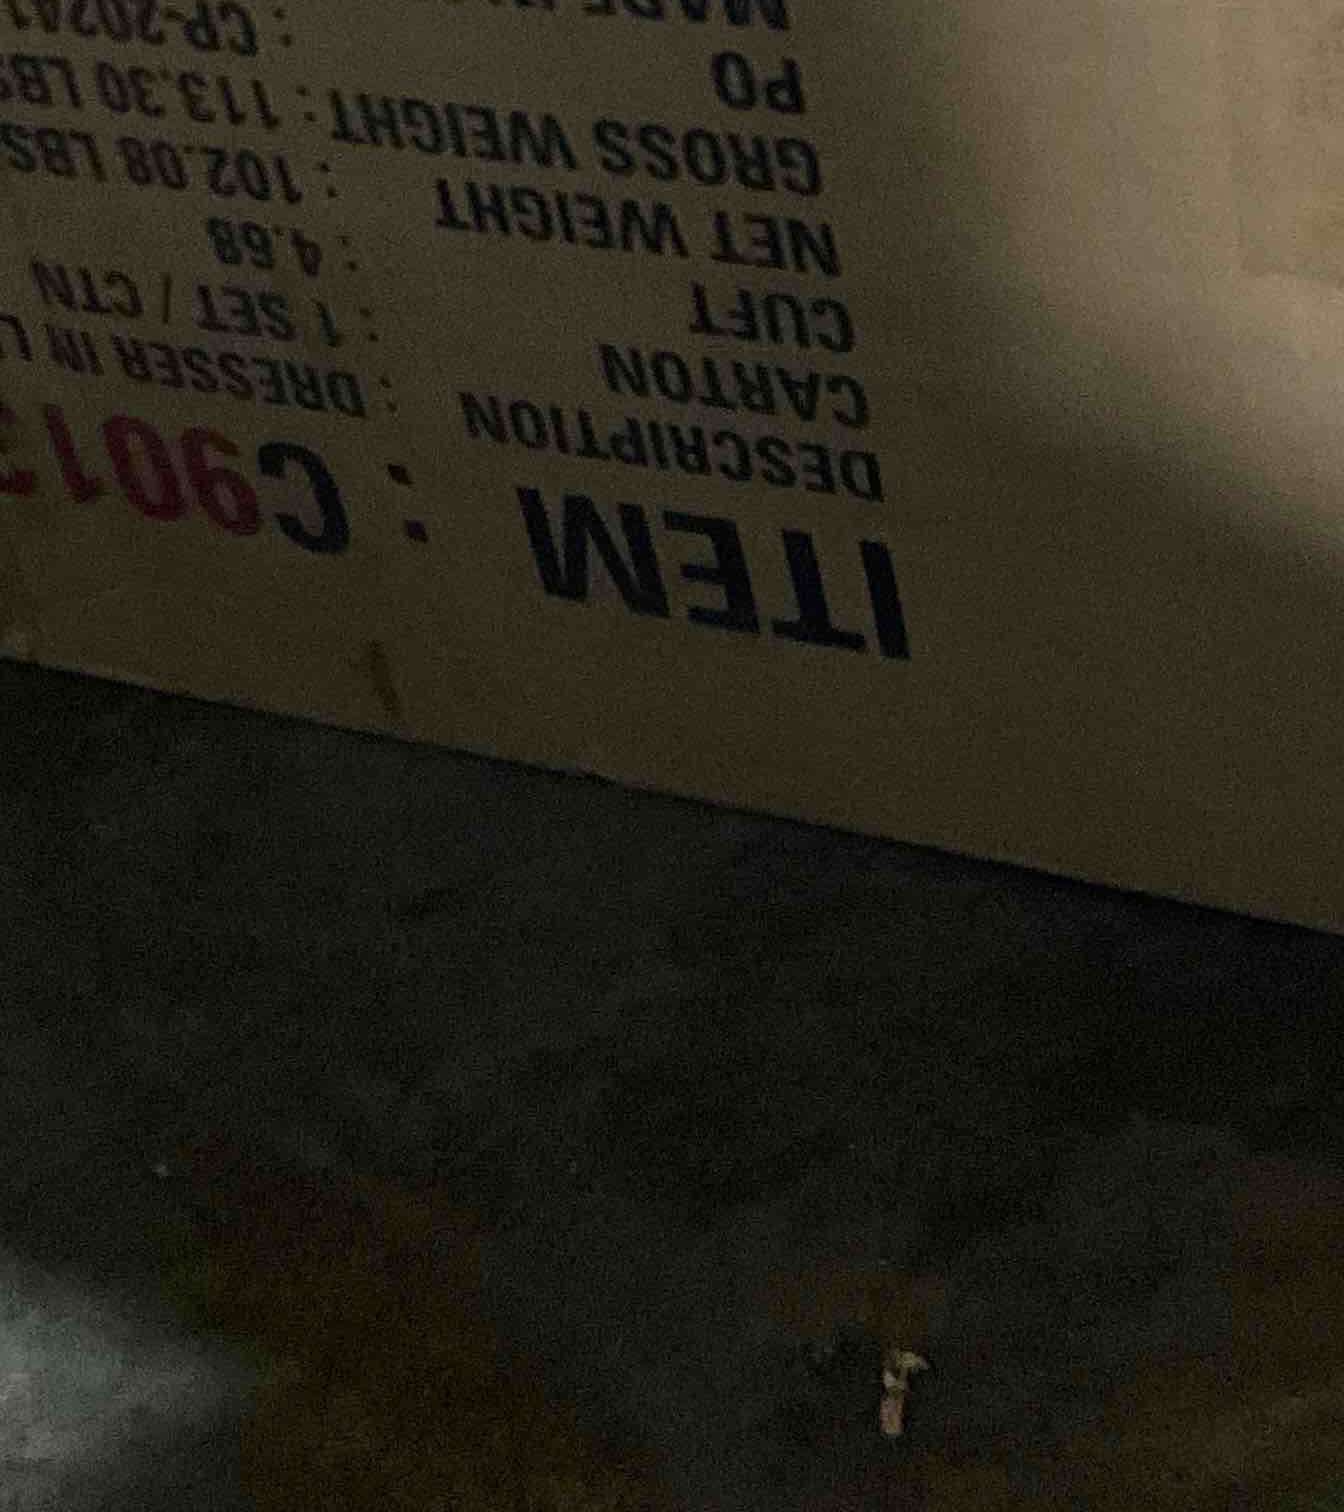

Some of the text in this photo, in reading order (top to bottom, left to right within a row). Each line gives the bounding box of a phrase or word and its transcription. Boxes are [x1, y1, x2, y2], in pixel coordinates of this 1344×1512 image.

[94, 60, 280, 130] 113.30
[710, 49, 806, 115] PO
[330, 88, 578, 171] WEIGHT
[591, 117, 822, 197] GROSS
[114, 135, 303, 204] 102.08
[206, 216, 323, 278] 4.68
[434, 177, 689, 259] WEIGHT
[711, 209, 842, 279] NET
[28, 260, 146, 318] CTN
[193, 283, 298, 341] SET
[314, 299, 346, 348] 1
[688, 282, 856, 354] CUFT
[45, 323, 105, 377] IN
[112, 330, 367, 418] DRESSER
[597, 343, 870, 430] CARTON
[458, 390, 884, 503] DESCRIPTION
[517, 487, 911, 663] ITEM
